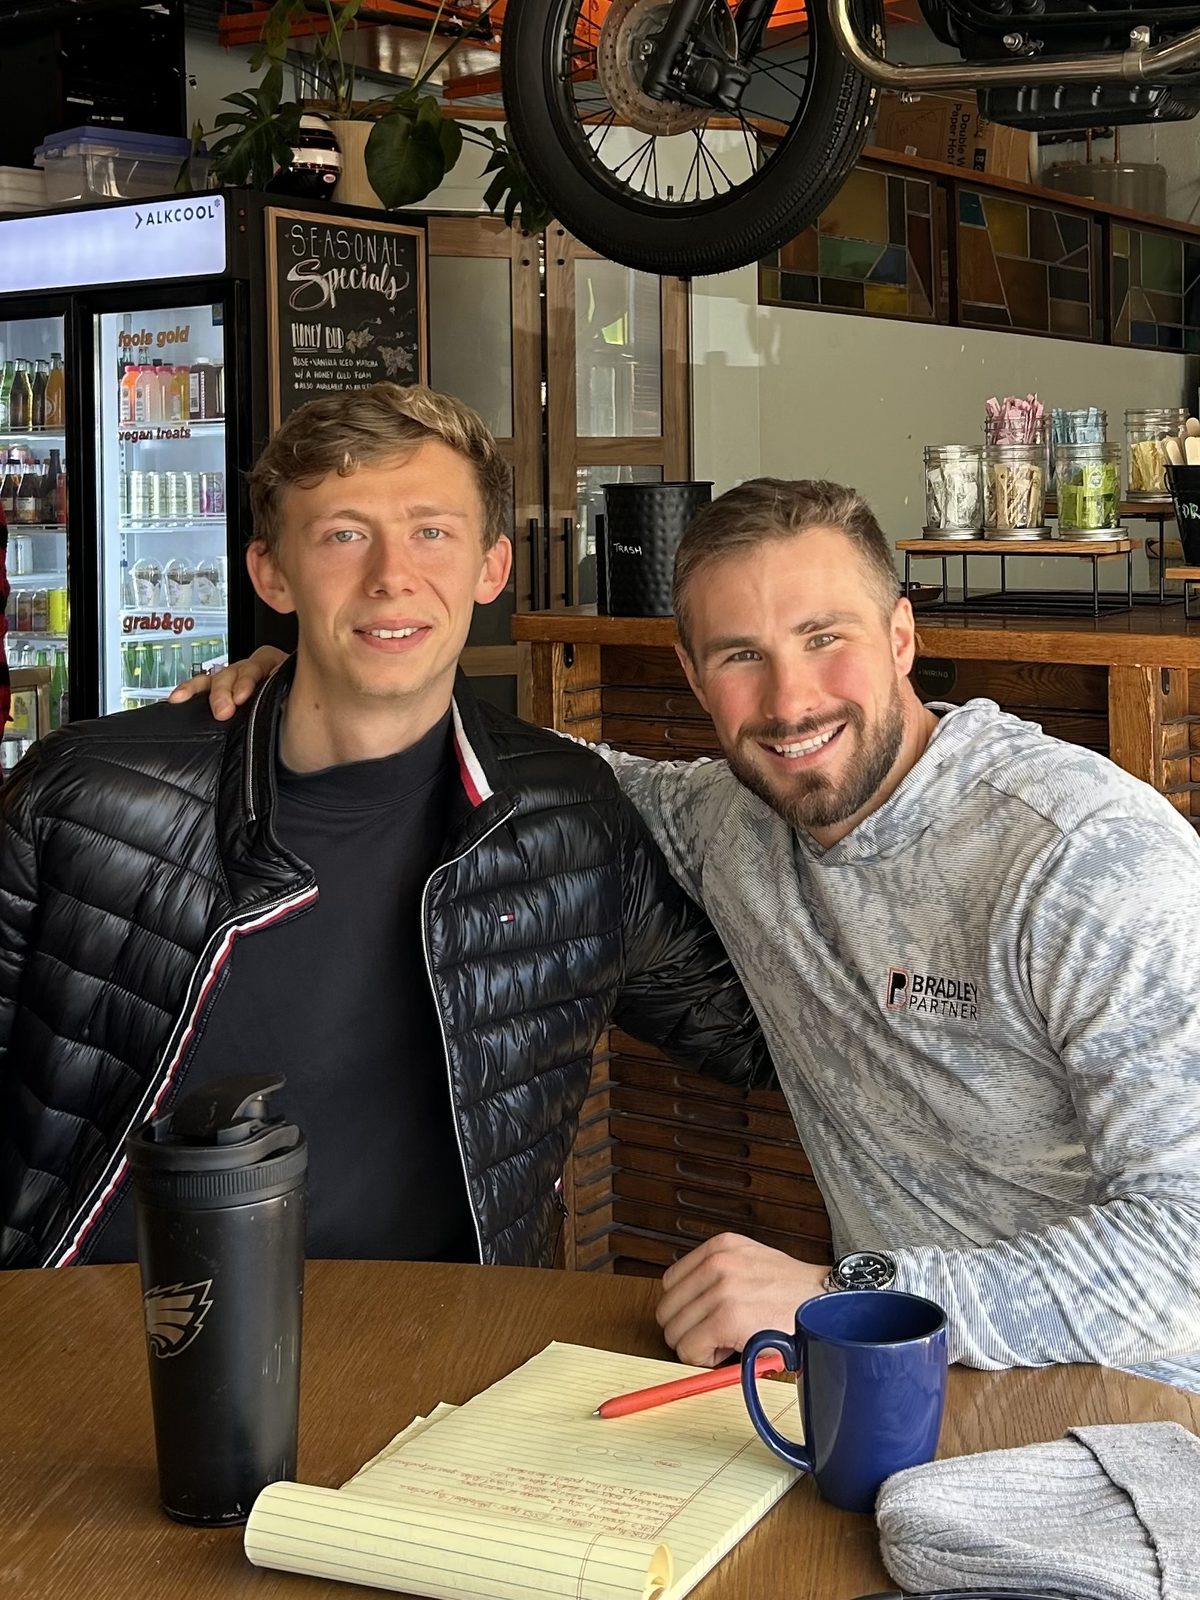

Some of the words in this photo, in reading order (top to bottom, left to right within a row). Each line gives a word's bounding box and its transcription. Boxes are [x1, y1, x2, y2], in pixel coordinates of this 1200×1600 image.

[949, 103, 962, 135] Paper
[957, 113, 971, 154] Double
[947, 138, 957, 159] Hot
[290, 224, 404, 267] SEASONAL
[286, 258, 410, 312] Specials
[118, 328, 153, 347] fools
[156, 325, 190, 348] gold
[291, 322, 322, 349] HONEY
[325, 326, 345, 349] BUD
[313, 370, 334, 379] HONEY
[354, 370, 372, 379] FOAM
[118, 429, 153, 443] vegan
[156, 427, 192, 439] treats
[122, 612, 195, 634] grab&go
[911, 974, 978, 1004] BRADLEY
[908, 995, 978, 1020] PARTNER
